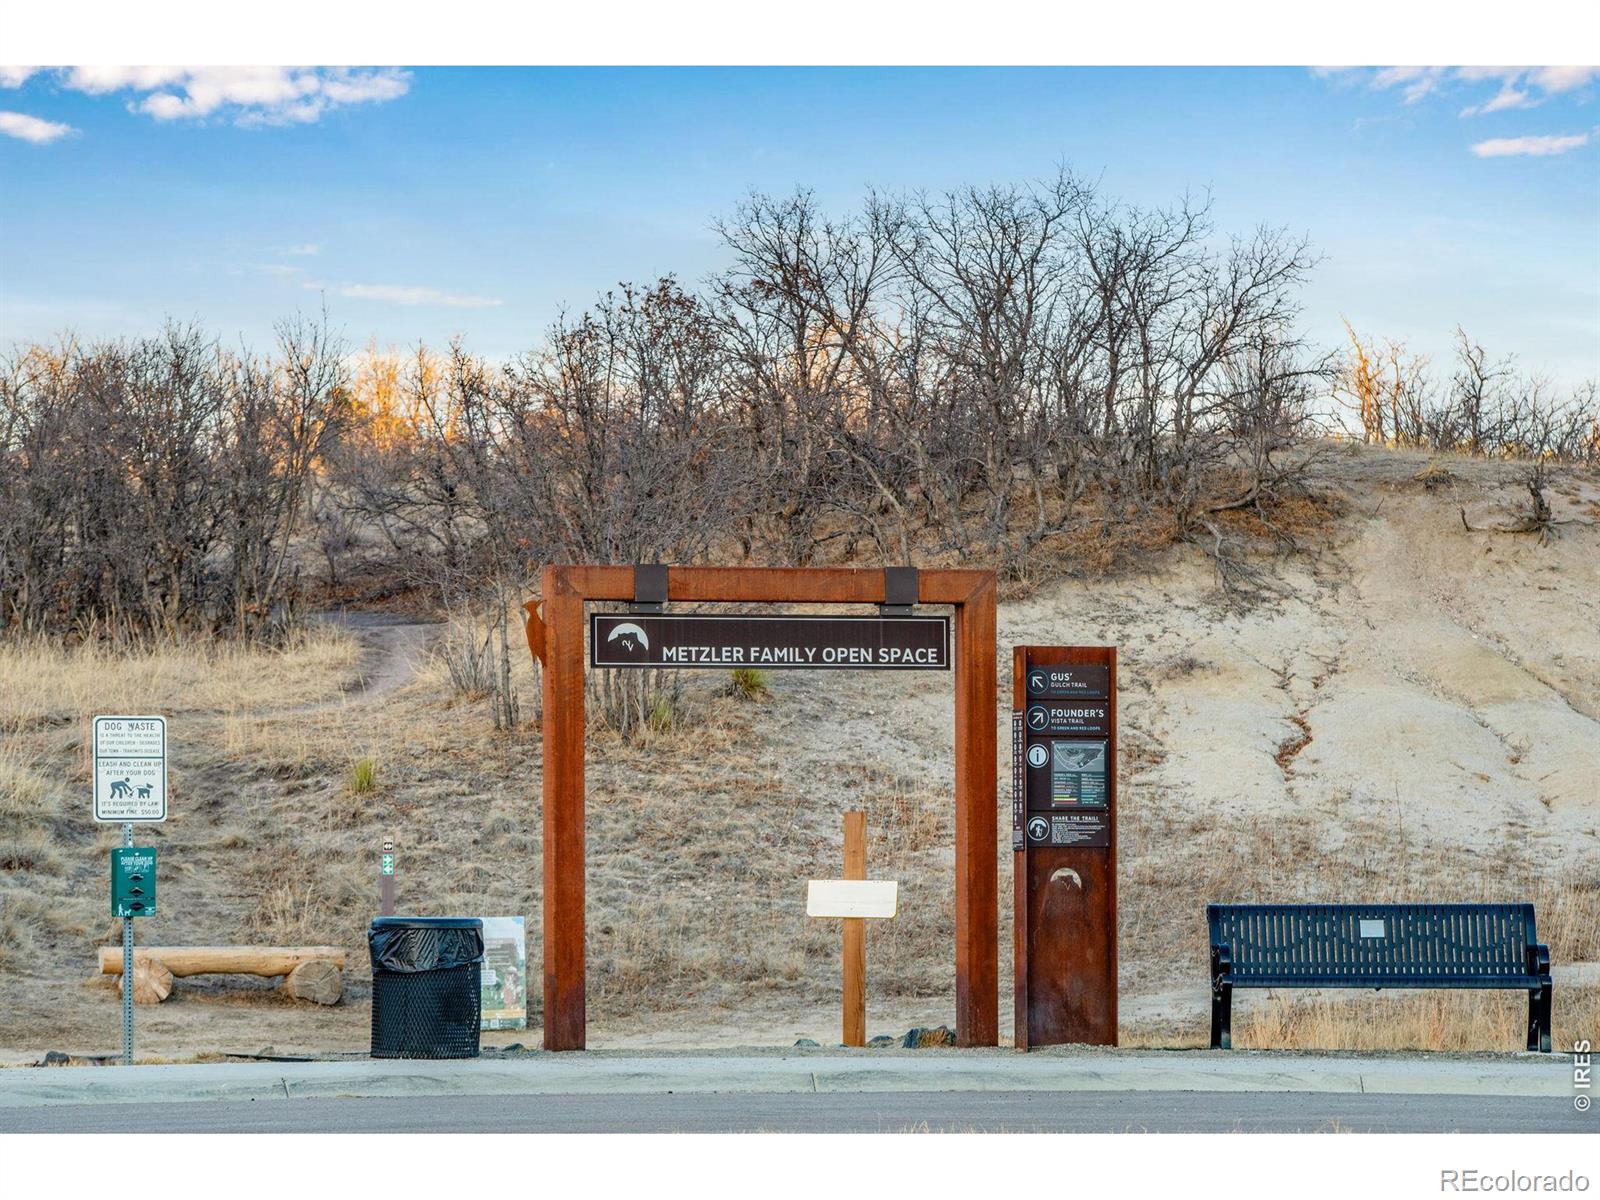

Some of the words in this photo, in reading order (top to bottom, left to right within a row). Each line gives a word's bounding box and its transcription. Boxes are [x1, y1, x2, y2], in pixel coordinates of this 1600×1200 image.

[662, 646, 744, 662] METZLER
[750, 647, 817, 662] FAMILY
[822, 647, 872, 663] OPEN
[878, 647, 938, 663] SPACE
[1051, 709, 1104, 717] FOUNDER'S
[104, 722, 122, 730] DOG
[128, 722, 155, 730] WASTE
